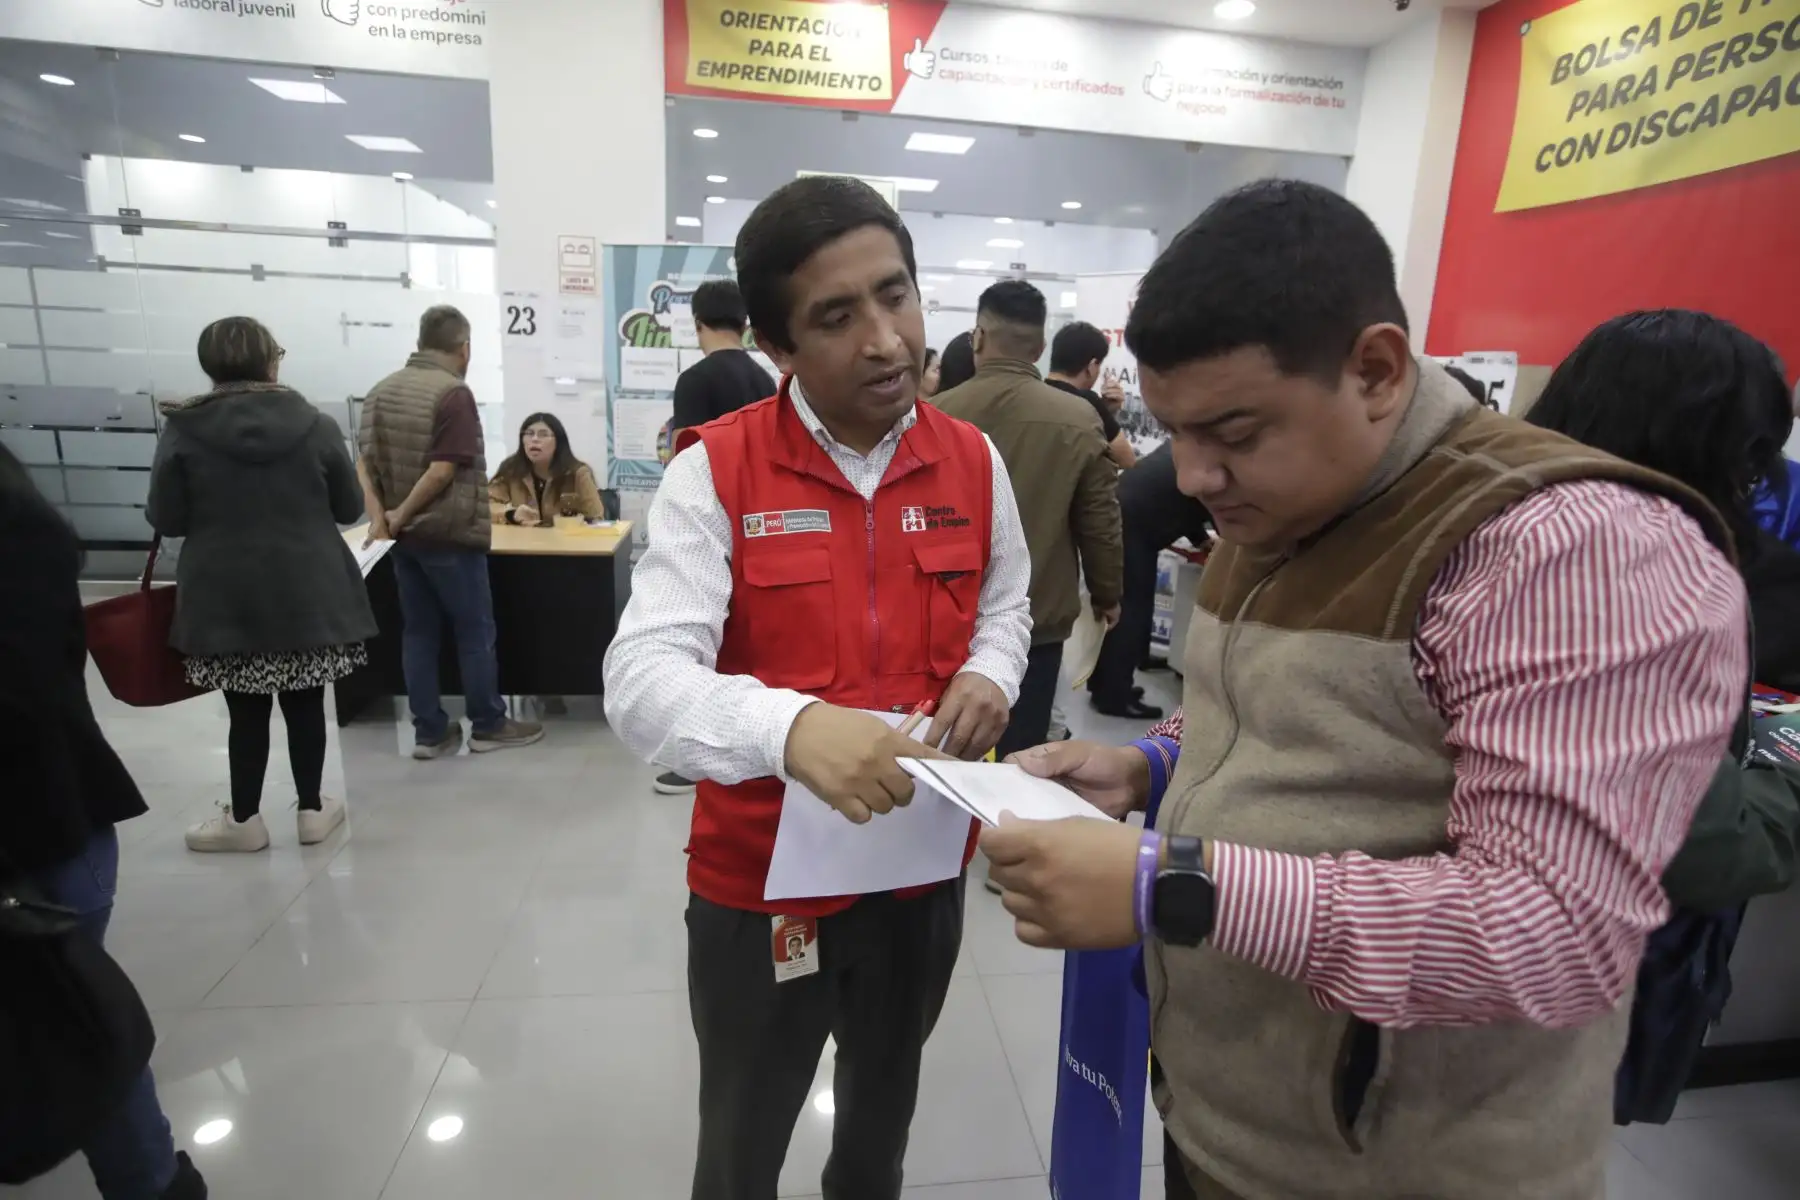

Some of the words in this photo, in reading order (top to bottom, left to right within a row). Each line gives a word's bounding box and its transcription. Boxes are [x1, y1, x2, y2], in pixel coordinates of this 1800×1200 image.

[237, 0, 295, 18] juvenil
[367, 4, 397, 17] con
[401, 7, 486, 25] predomini
[368, 25, 389, 37] en
[392, 23, 406, 39] la
[410, 28, 482, 47] empresa
[720, 10, 861, 38] ORIENTACI
[749, 39, 804, 59] PARA
[809, 45, 832, 62] EL
[1550, 16, 1661, 86] BOLSA
[1668, 0, 1724, 41] DE
[697, 60, 882, 92] EMPRENDIMIENTO
[1262, 73, 1270, 86] y
[1270, 73, 1344, 90] orientación
[1313, 94, 1330, 106] de
[1332, 96, 1345, 108] tu
[1565, 65, 1659, 123] PARA
[1534, 129, 1604, 173] CON
[507, 305, 536, 336] 23
[1081, 1062, 1096, 1087] tu
